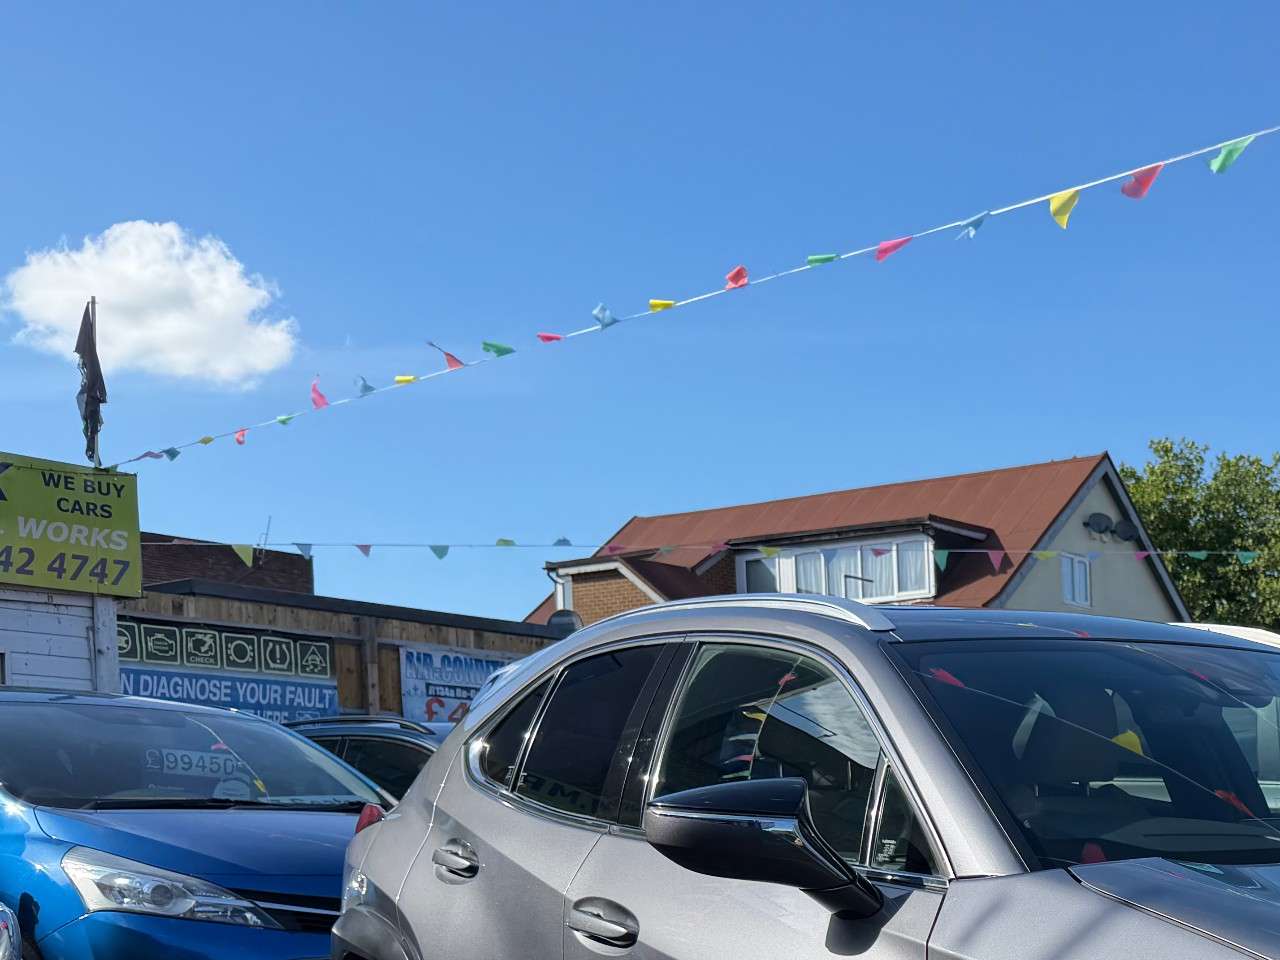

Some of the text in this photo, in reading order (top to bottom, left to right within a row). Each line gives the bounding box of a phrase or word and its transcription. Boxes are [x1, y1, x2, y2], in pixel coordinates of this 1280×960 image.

[41, 471, 125, 498] WE BUY
[56, 497, 113, 519] CARS
[16, 516, 129, 551] WORKS
[46, 552, 131, 586] 4747
[139, 674, 232, 701] DIAGNOSE
[236, 682, 282, 705] YOUR
